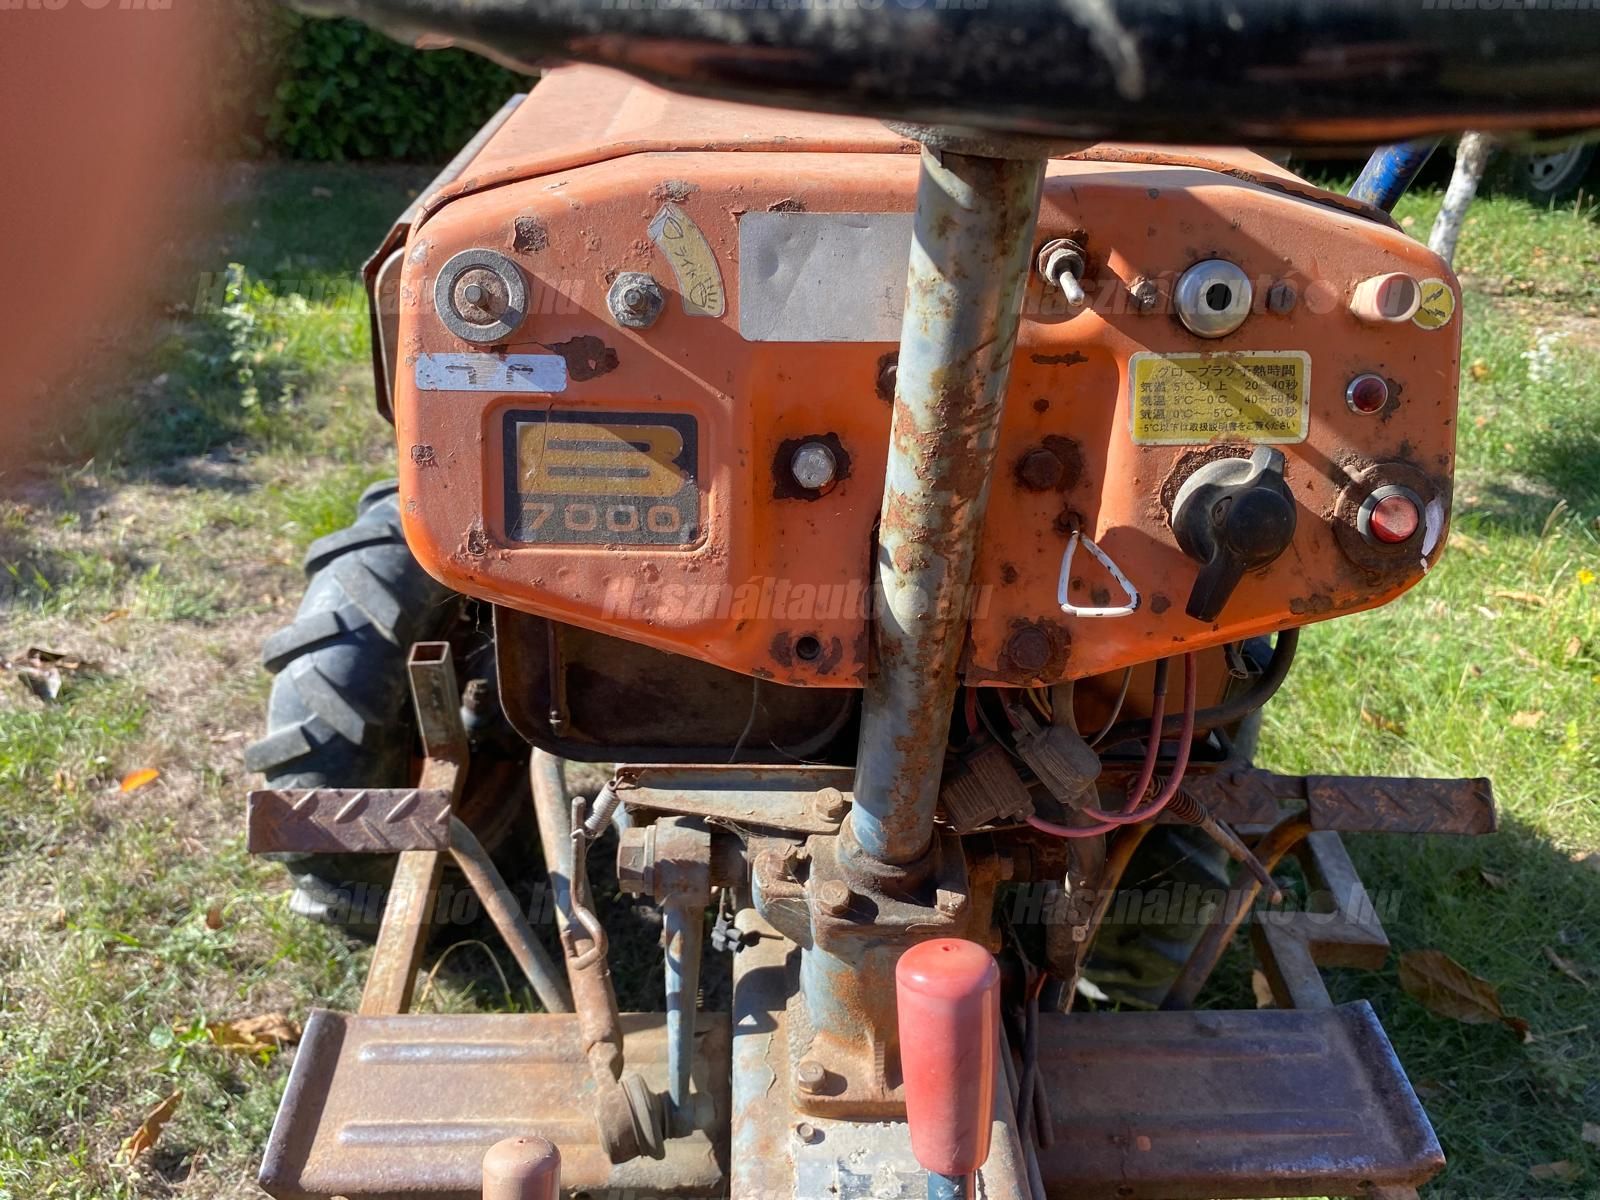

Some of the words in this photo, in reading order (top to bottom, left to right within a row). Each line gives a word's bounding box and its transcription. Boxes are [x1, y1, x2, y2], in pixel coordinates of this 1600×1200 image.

[1140, 381, 1166, 392] 気温
[1140, 395, 1165, 406] 気温
[1140, 409, 1165, 420] 気温
[522, 502, 682, 533] 7000
